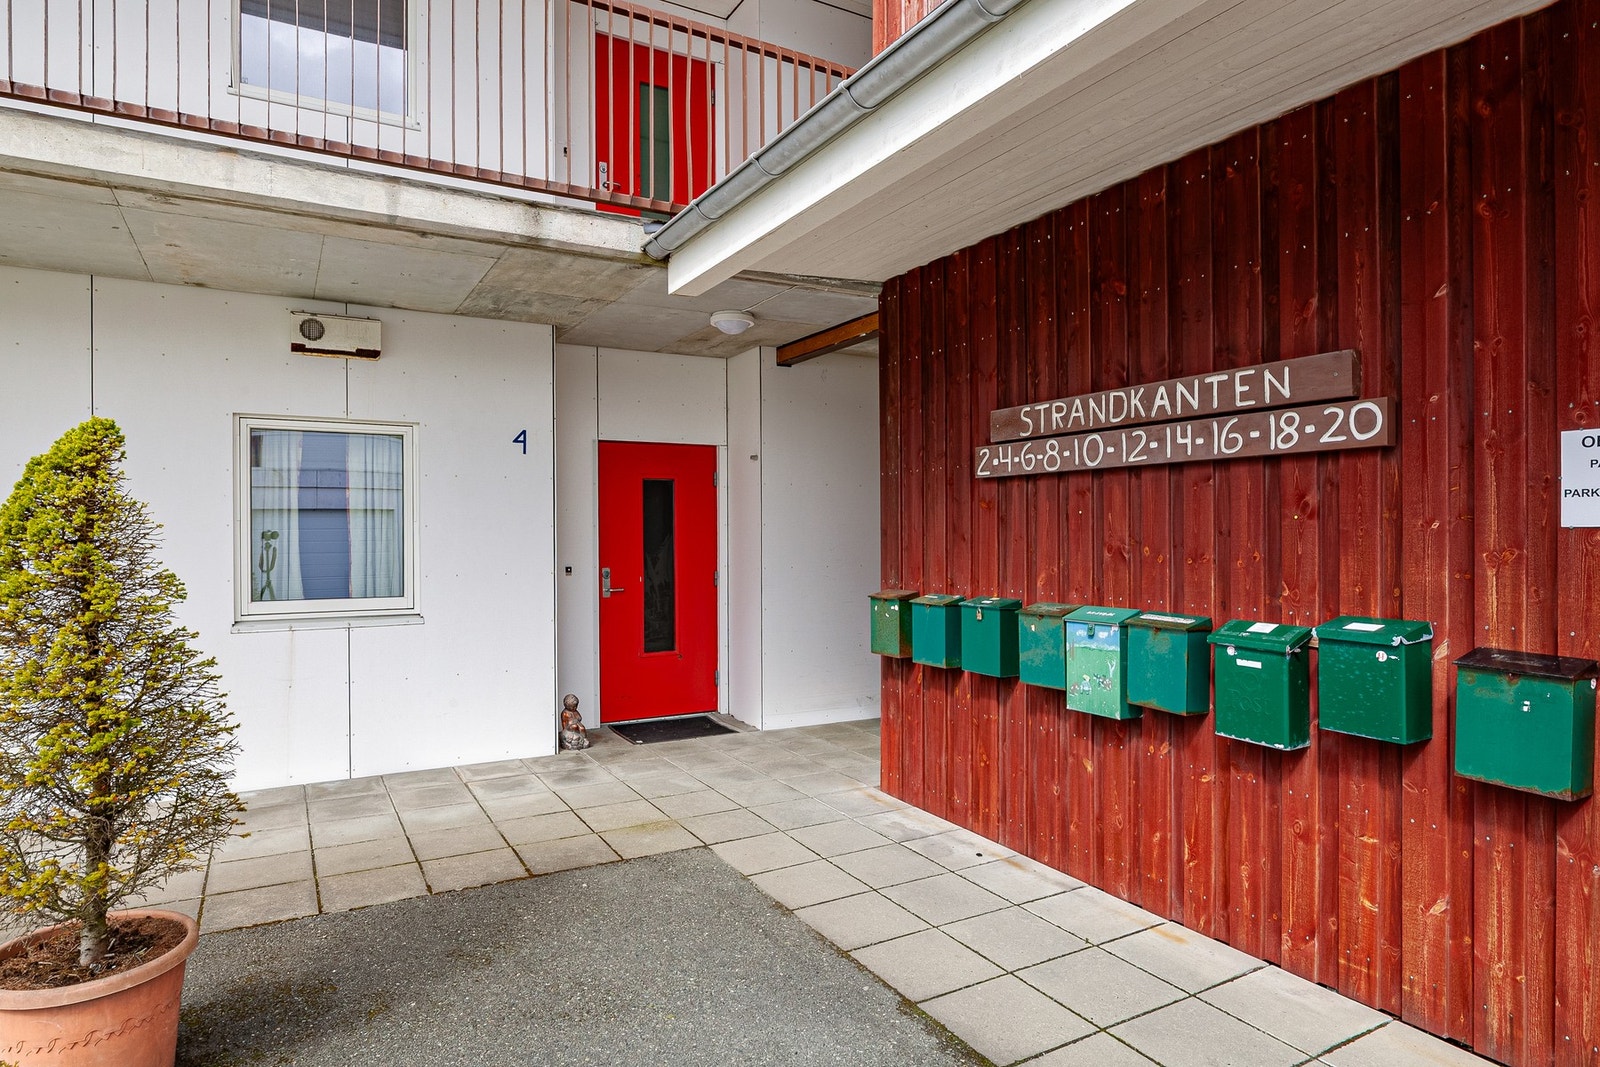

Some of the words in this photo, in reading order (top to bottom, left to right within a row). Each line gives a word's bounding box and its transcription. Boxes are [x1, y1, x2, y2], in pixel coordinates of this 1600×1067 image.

[1019, 366, 1291, 437] STRANDKANTEN
[512, 429, 527, 455] 4
[1590, 459, 1600, 468] P
